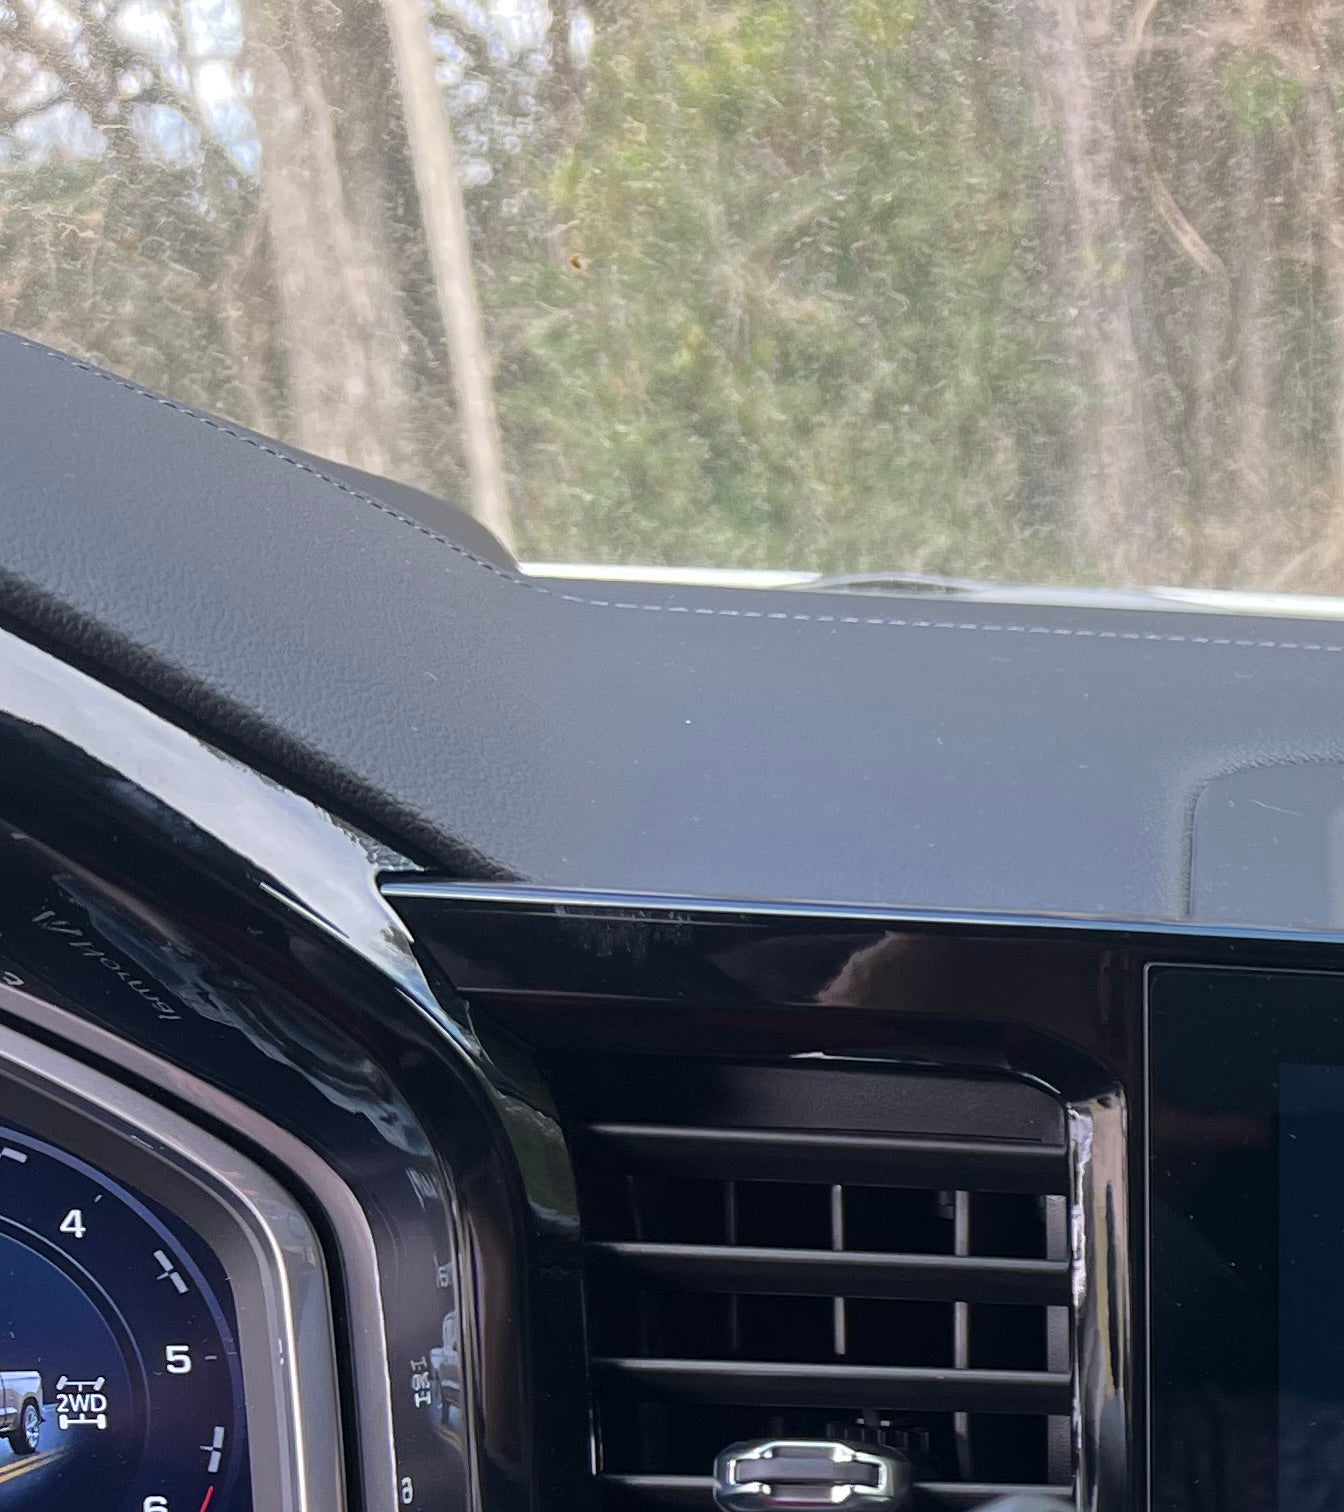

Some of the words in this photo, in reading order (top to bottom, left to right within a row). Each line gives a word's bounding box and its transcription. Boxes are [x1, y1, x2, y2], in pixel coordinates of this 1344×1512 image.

[59, 1208, 87, 1239] 4
[164, 1345, 192, 1374] 5
[56, 1393, 108, 1413] 2WD
